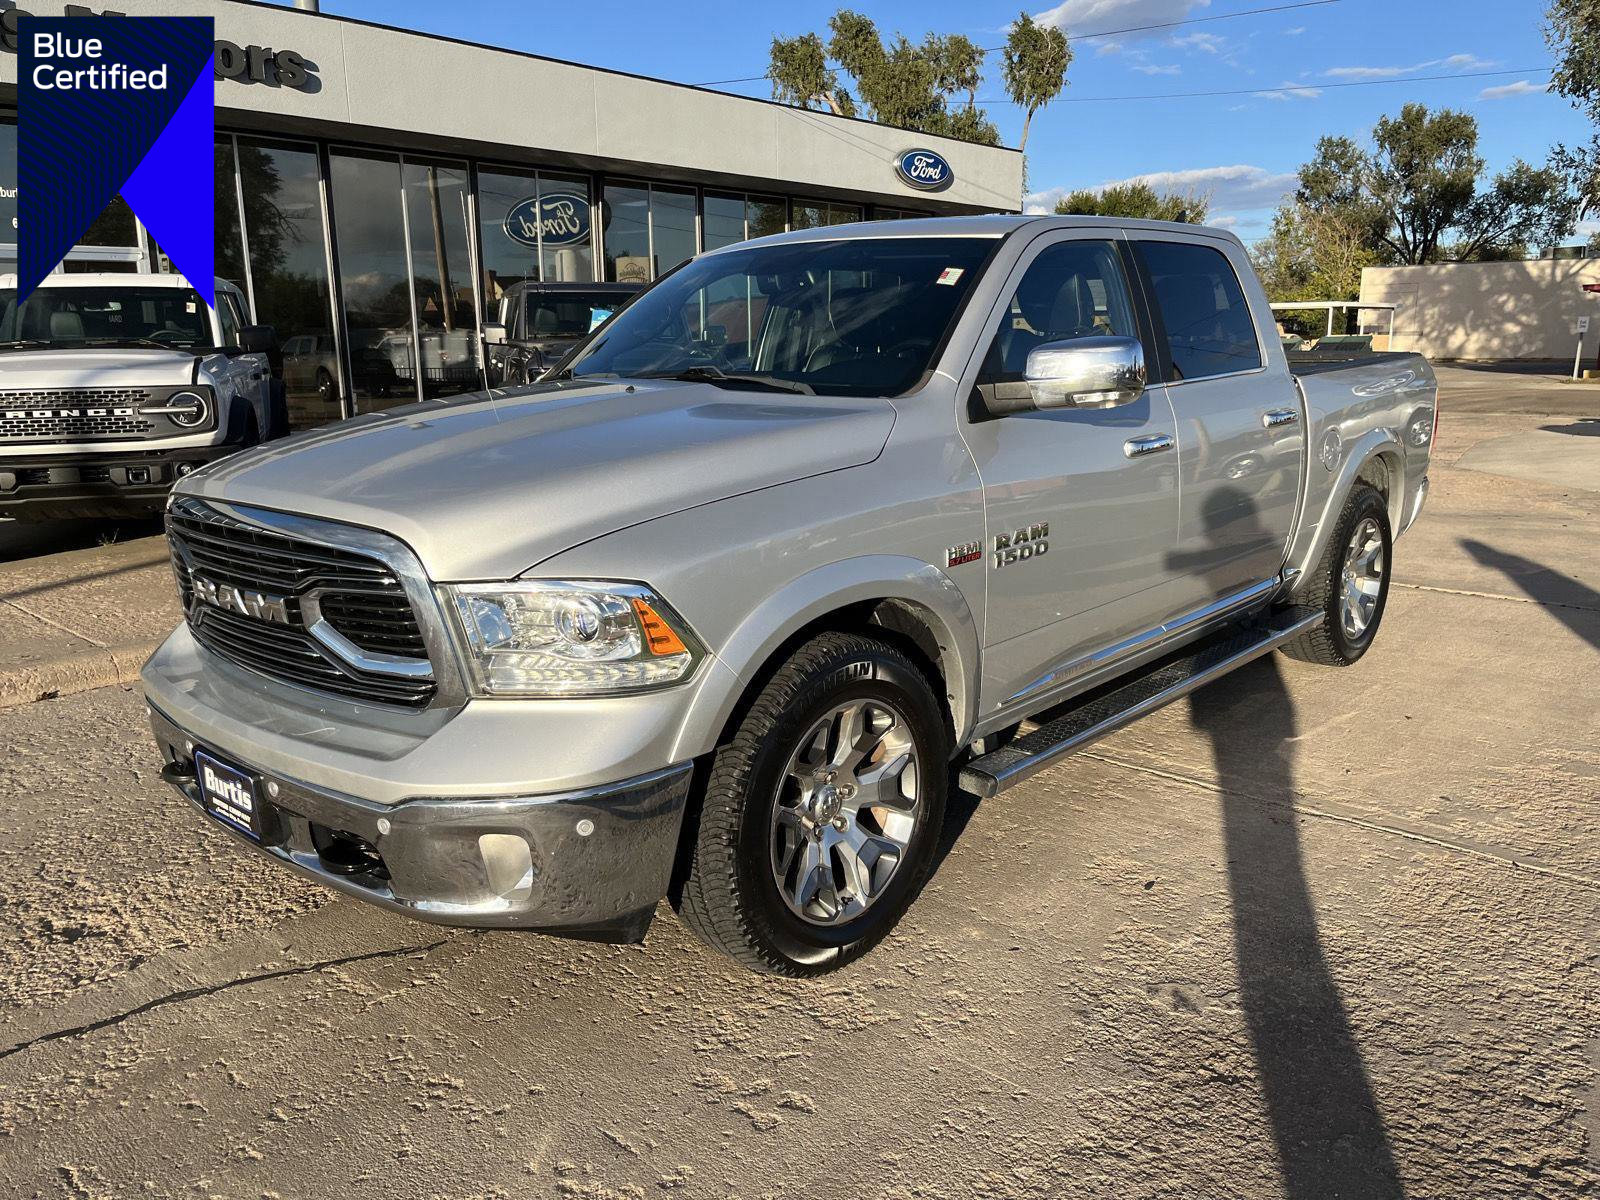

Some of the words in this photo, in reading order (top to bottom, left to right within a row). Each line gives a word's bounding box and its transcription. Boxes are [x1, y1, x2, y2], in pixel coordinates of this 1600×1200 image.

[214, 40, 306, 87] ors
[911, 155, 942, 180] Ford
[5, 408, 134, 419] RONCO
[993, 522, 1049, 552] RAM
[993, 540, 1049, 569] 1500
[191, 577, 290, 625] RAM
[203, 765, 253, 812] Burtis
